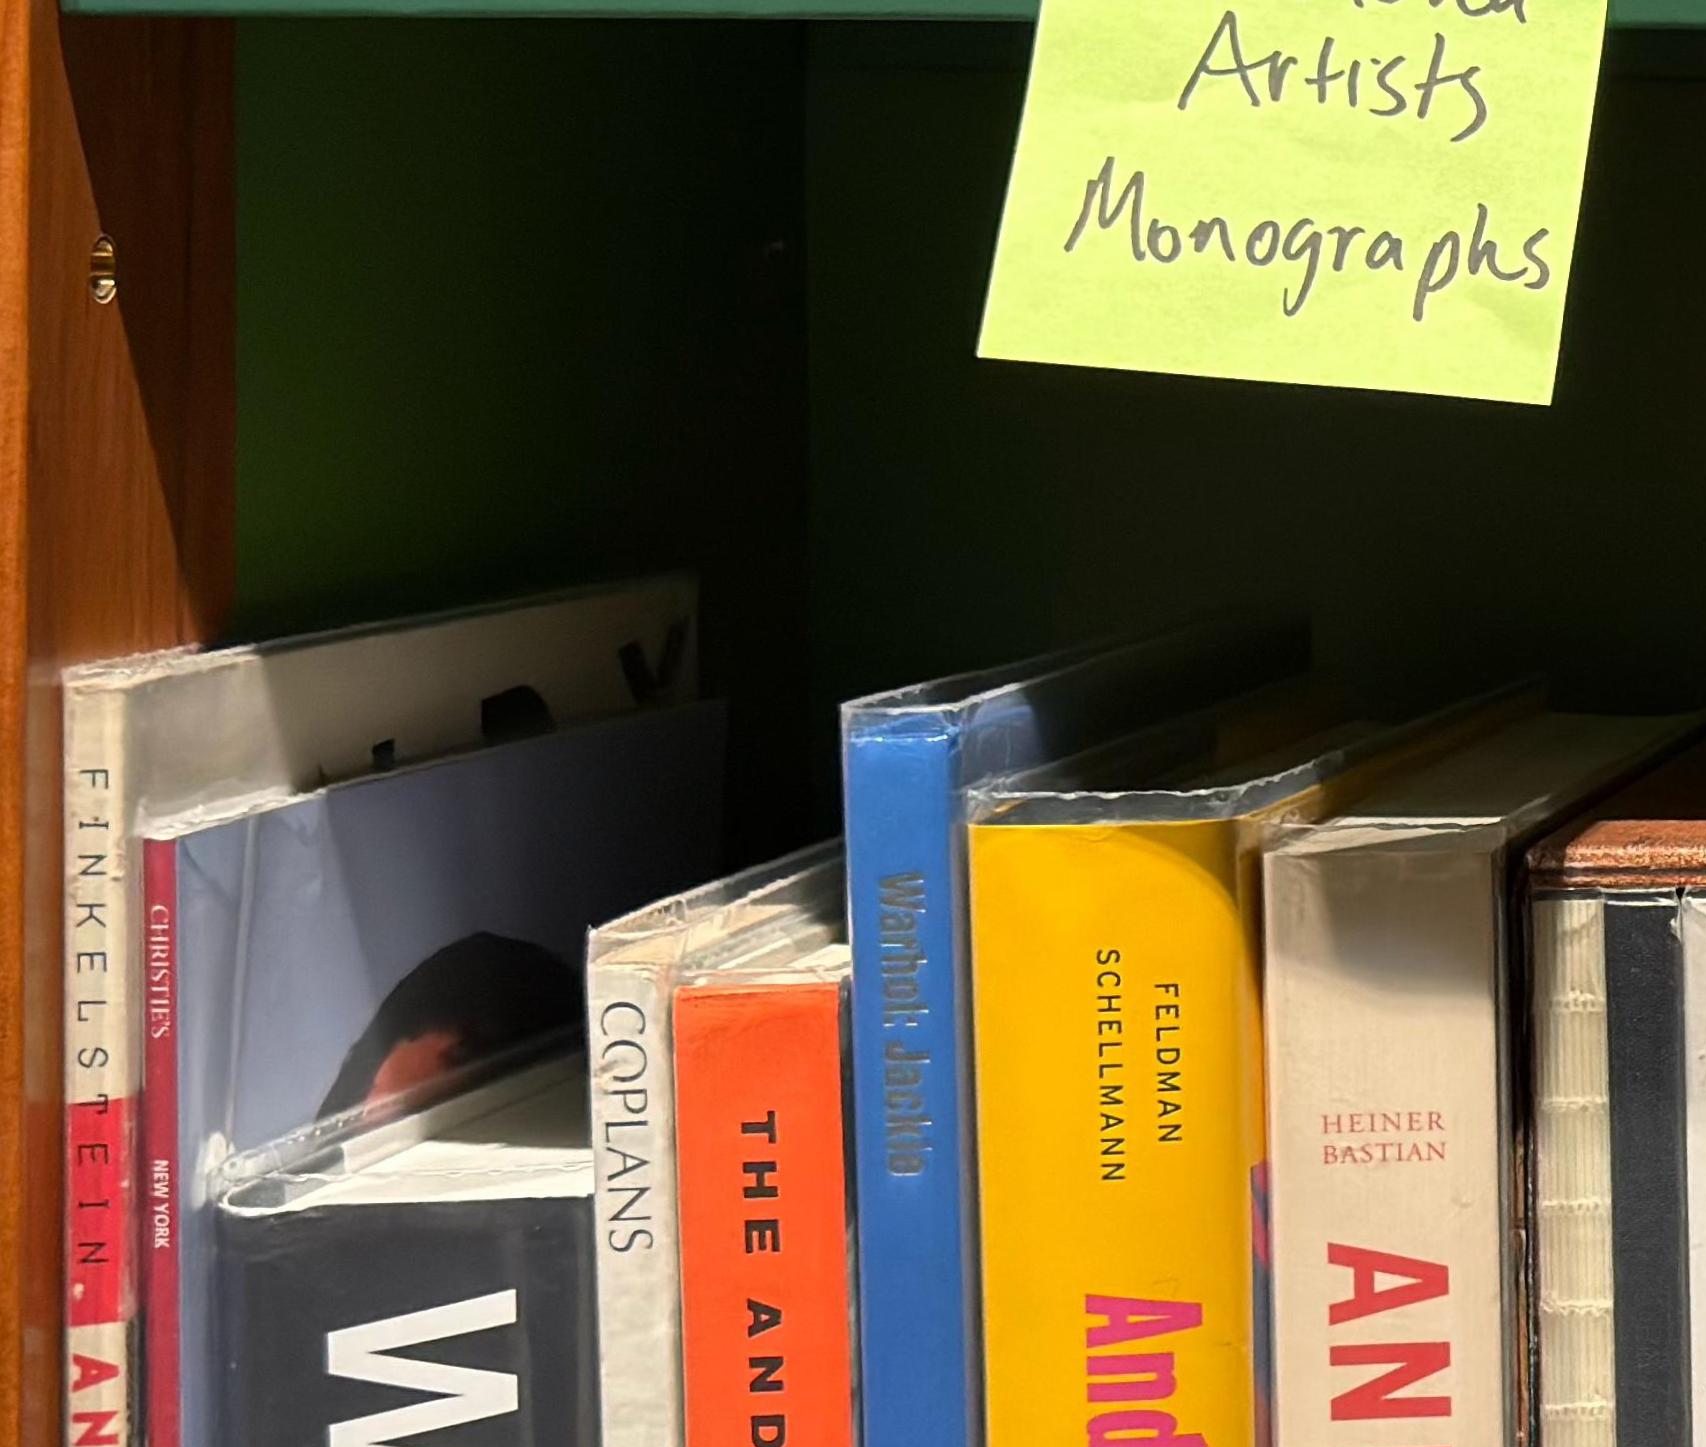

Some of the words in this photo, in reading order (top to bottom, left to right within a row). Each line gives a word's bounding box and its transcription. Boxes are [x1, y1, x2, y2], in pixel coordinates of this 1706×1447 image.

[1177, 12, 1490, 142] Artists
[1065, 156, 1554, 322] Monographs
[75, 766, 110, 1266] FINKELSTEIN
[1096, 949, 1125, 1181] SCHELLMANN
[1154, 983, 1182, 1143] FELDMAN
[153, 1159, 170, 1197] NEW
[599, 1000, 654, 1253] COPLANS
[740, 1110, 781, 1254] THE
[1322, 1111, 1445, 1135] HEINER
[1322, 1140, 1447, 1165] BASTIAN
[153, 1202, 170, 1249] YORK
